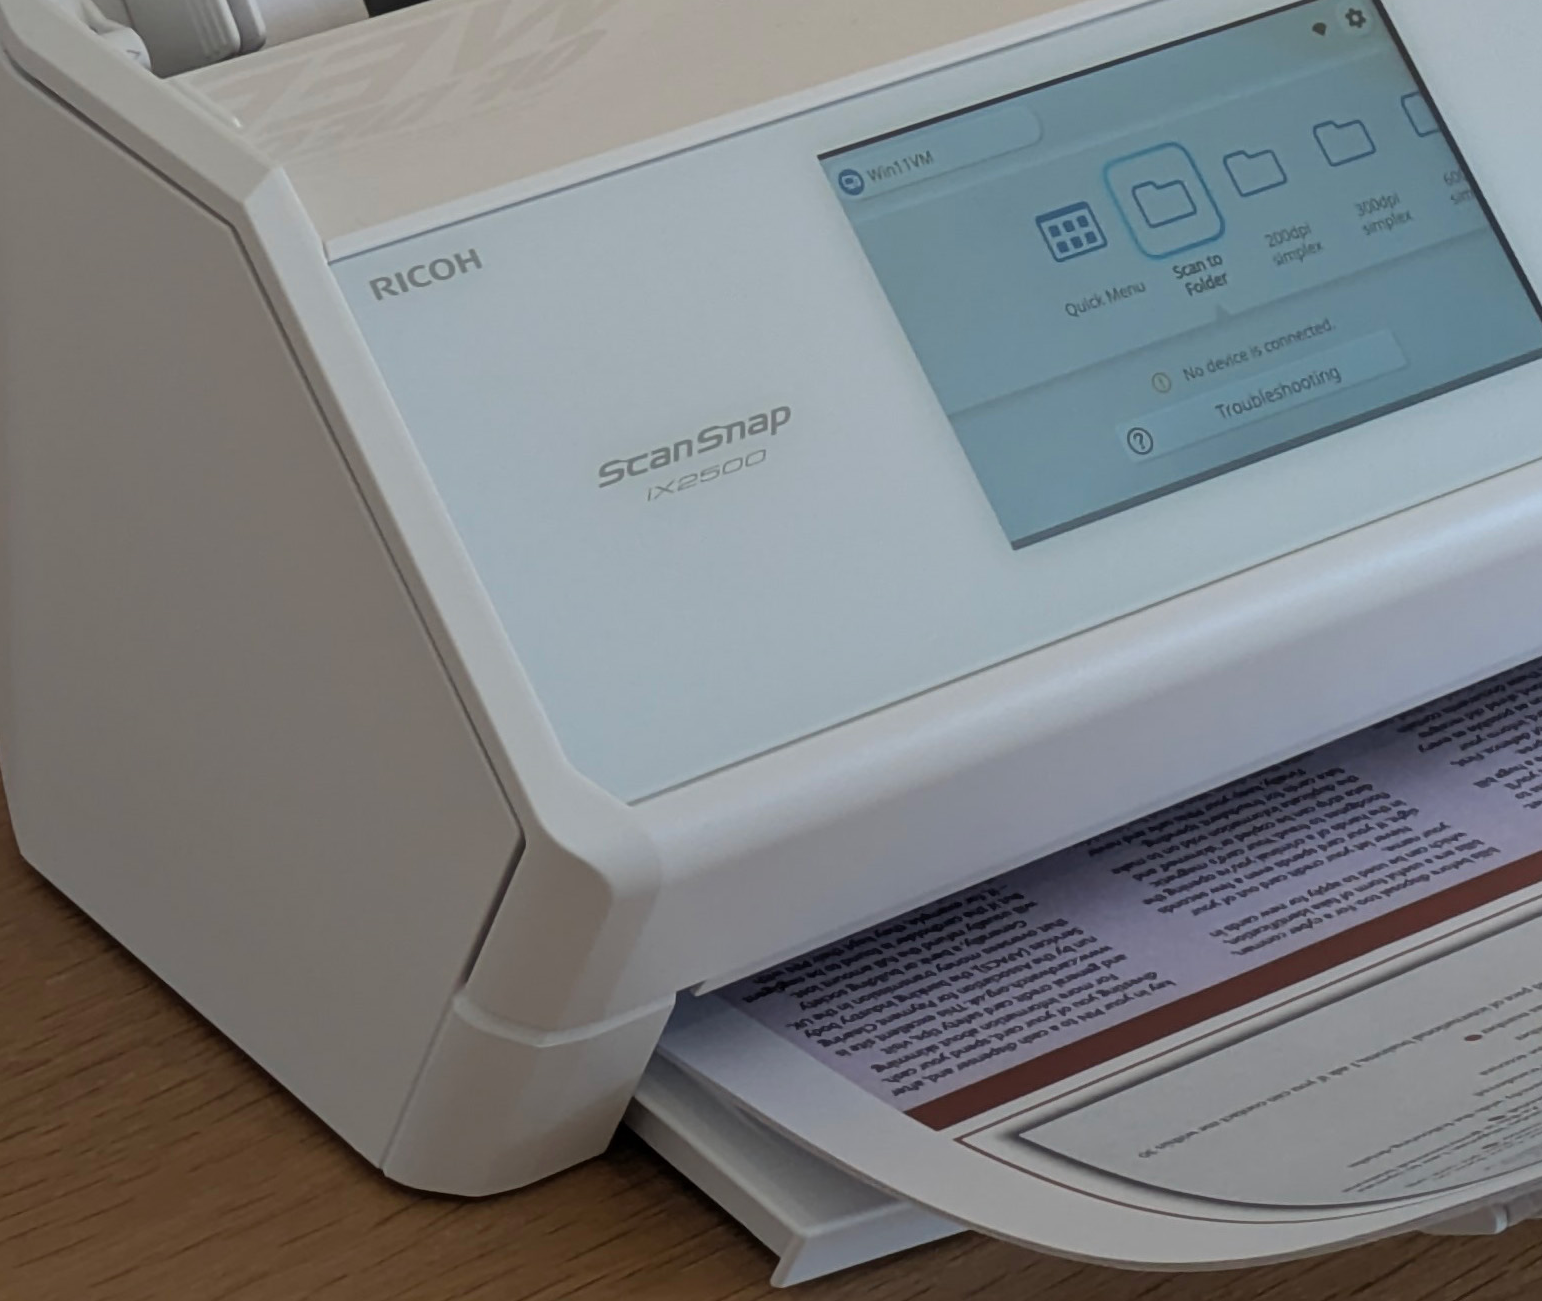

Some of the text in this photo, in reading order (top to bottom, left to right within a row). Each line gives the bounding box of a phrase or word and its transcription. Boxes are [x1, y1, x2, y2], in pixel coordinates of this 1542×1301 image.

[865, 149, 935, 183] Win11VM
[1354, 192, 1401, 218] 300dpi
[1263, 223, 1313, 249] 200dpi
[1361, 209, 1414, 237] simplex
[1171, 253, 1224, 281] Scan to
[1272, 241, 1324, 267] simplex
[369, 248, 483, 301] RICOH
[1184, 271, 1229, 298] Folder
[1064, 281, 1147, 318] Quick Menu
[1181, 317, 1333, 382] No device is connected.
[1214, 366, 1343, 420] Troubleshooting
[598, 405, 792, 489] ScanSnap
